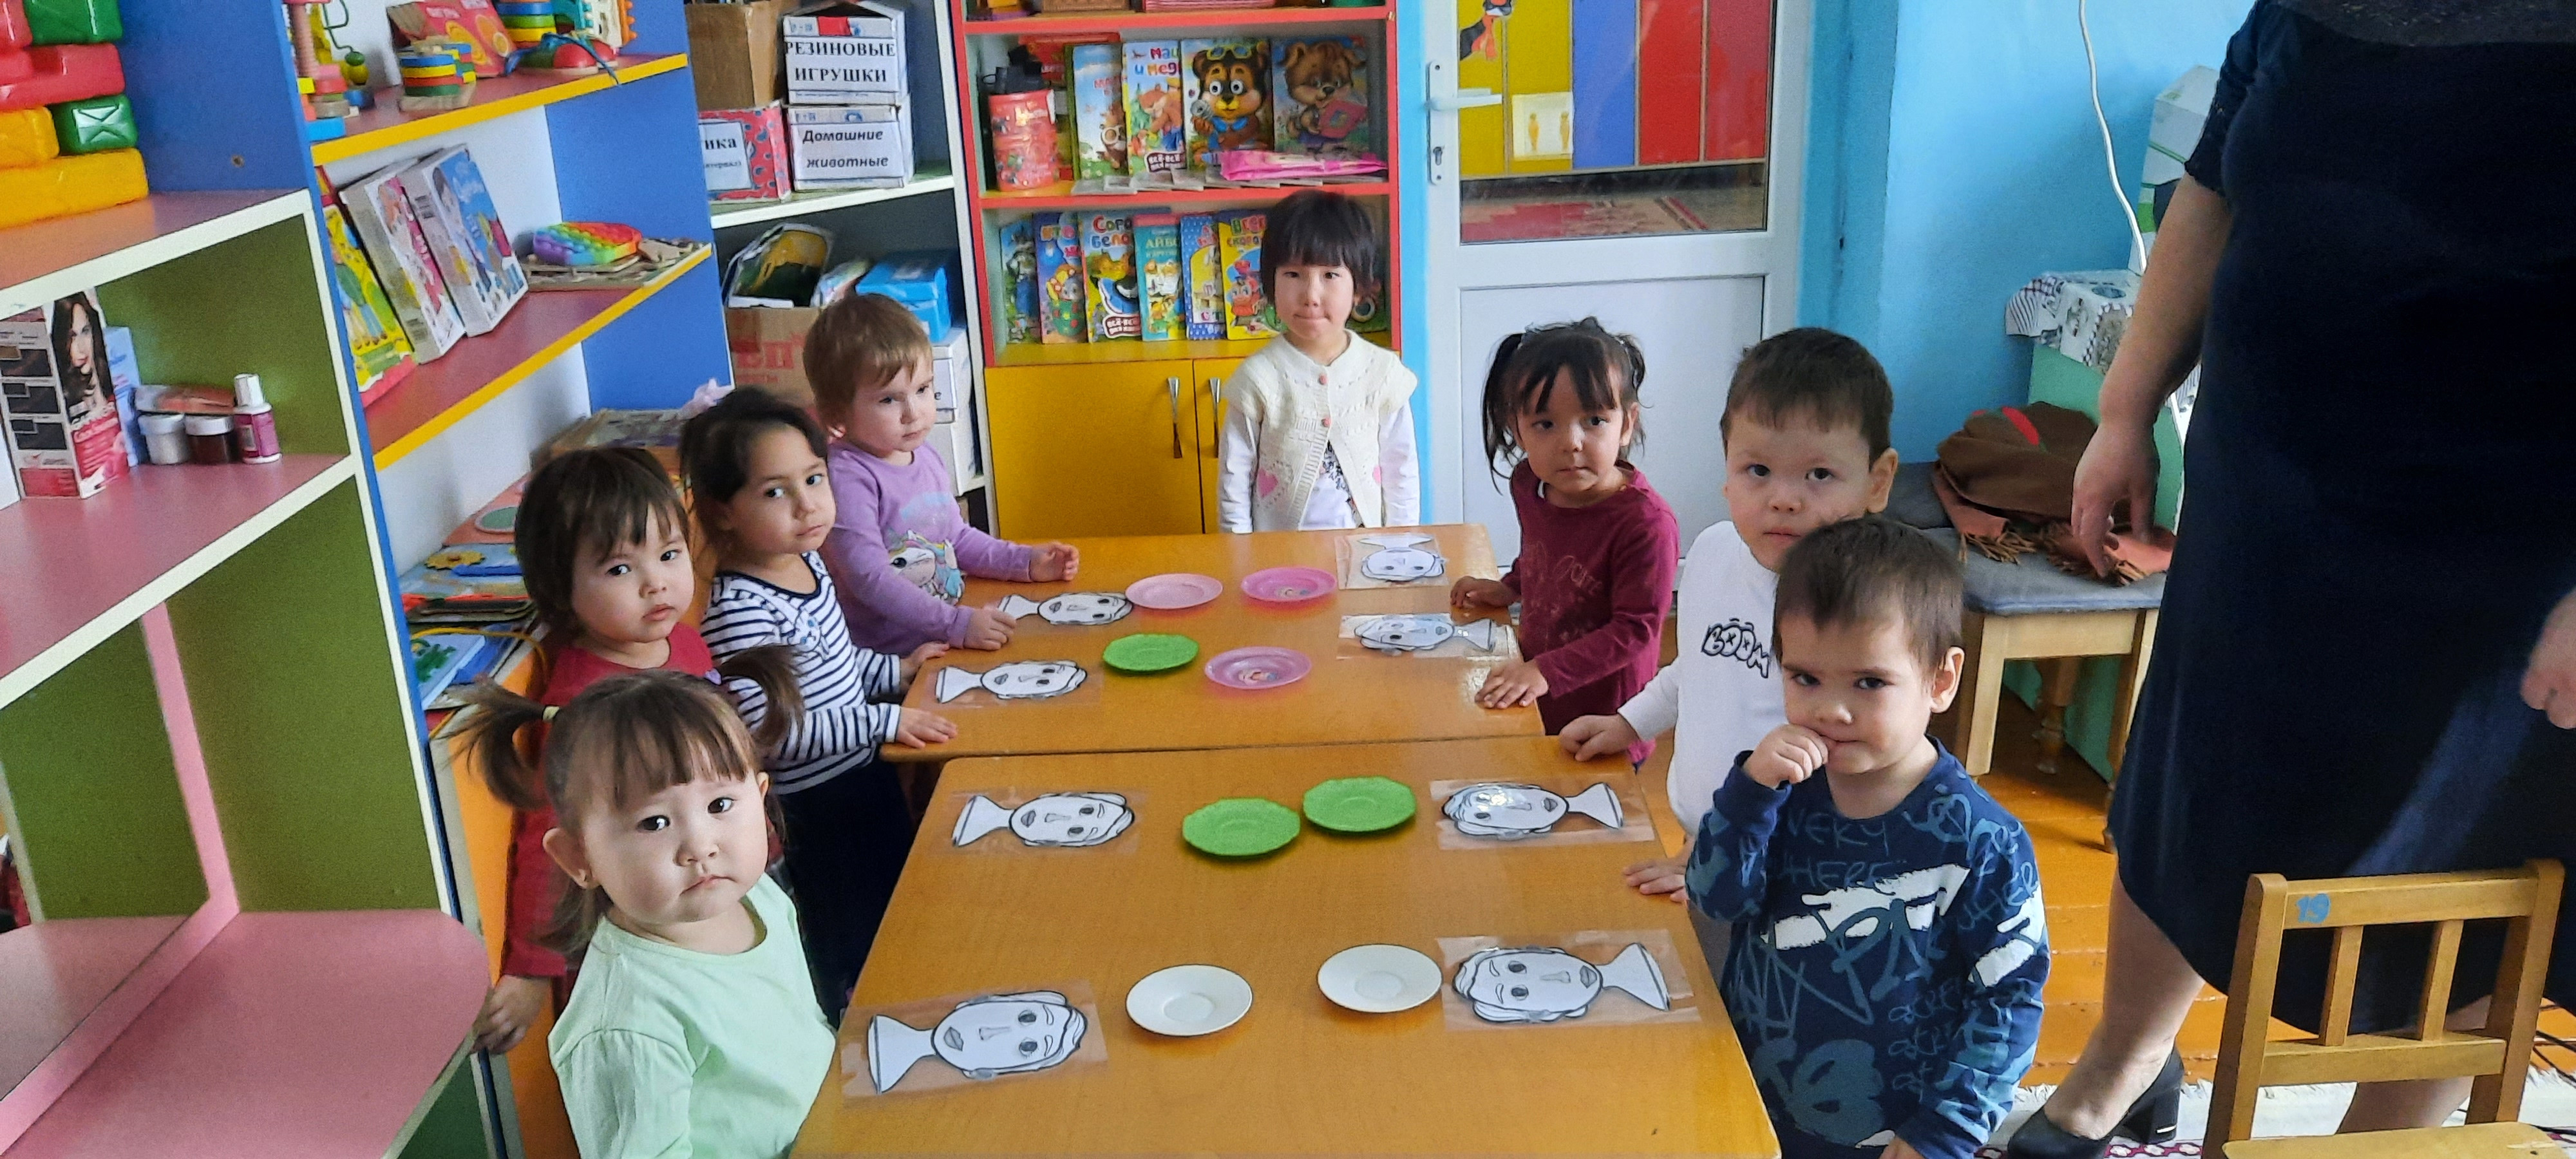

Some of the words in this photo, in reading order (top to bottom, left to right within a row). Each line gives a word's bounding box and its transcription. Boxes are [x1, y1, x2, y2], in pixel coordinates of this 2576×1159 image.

[785, 41, 895, 57] РЕЗИНОВЫЕ
[795, 67, 886, 82] ИГРУШКИ
[802, 130, 883, 144] Домашние
[806, 156, 889, 168] животные
[2297, 892, 2331, 924] 19
